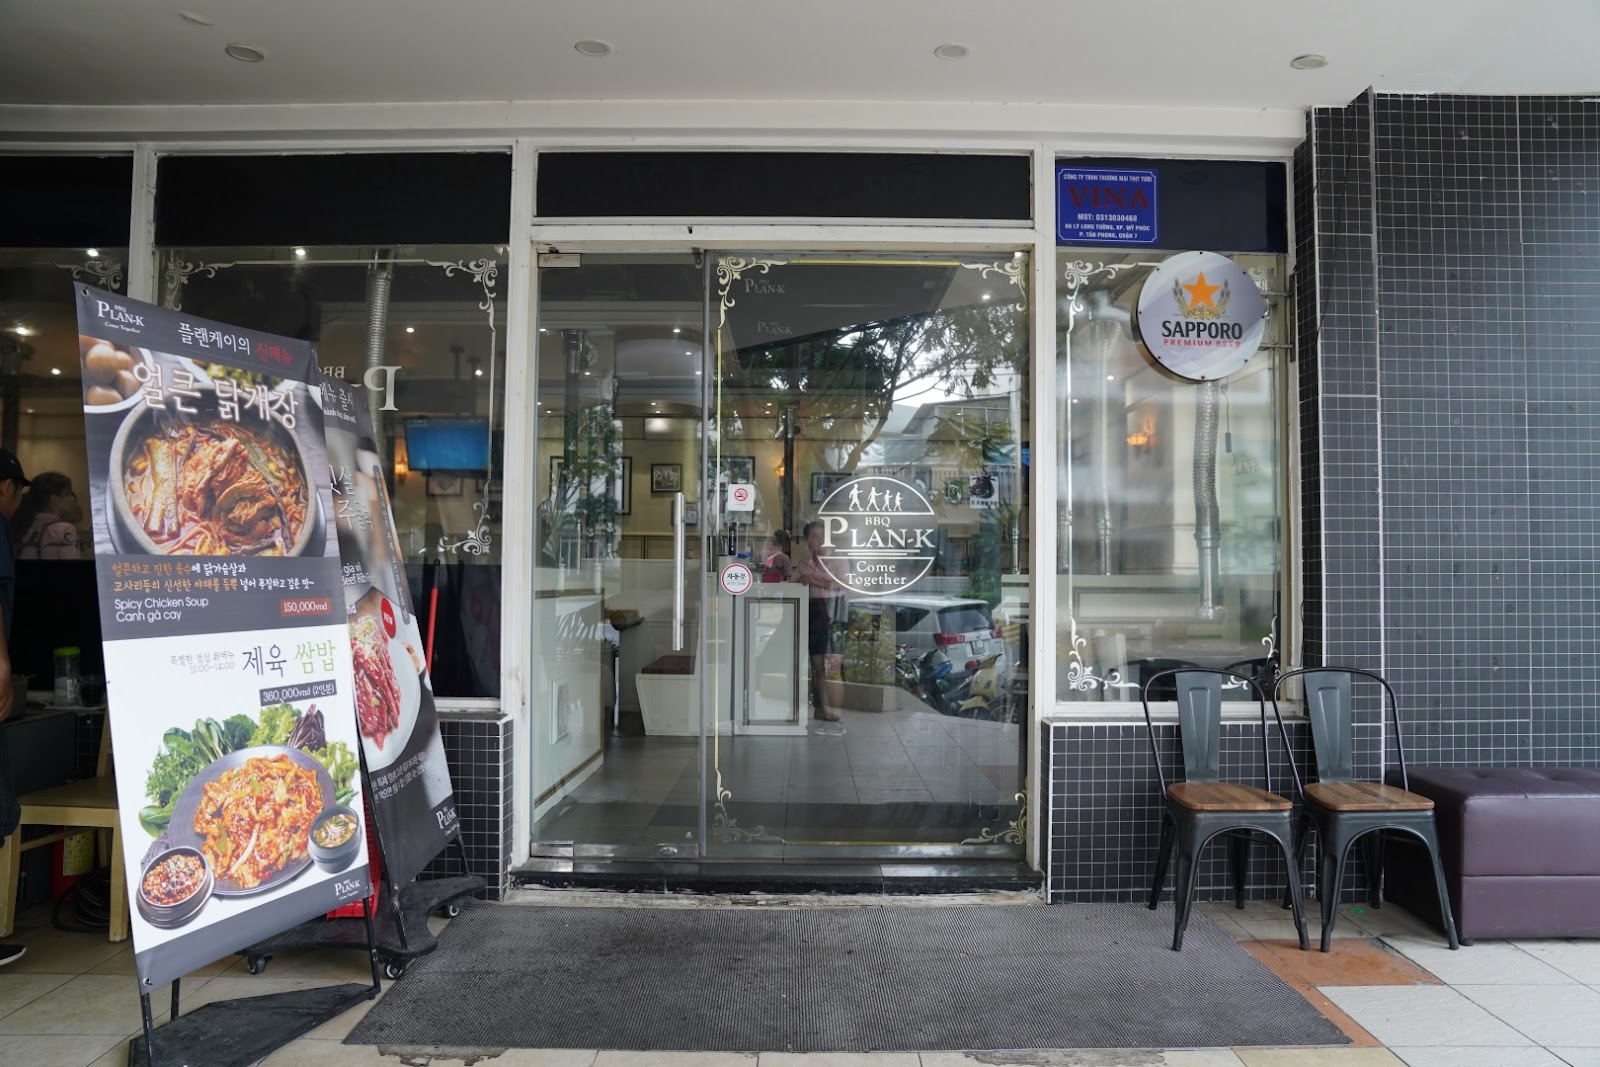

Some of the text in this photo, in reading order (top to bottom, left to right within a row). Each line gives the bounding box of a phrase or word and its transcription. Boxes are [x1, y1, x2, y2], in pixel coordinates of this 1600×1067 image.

[1069, 186, 1149, 208] VINA
[1162, 320, 1243, 340] SAPPORO
[178, 322, 250, 355] 플랜케이의
[1163, 339, 1241, 348] PREMIUM BEER
[133, 363, 298, 429] 얼큰 닭개장
[865, 516, 891, 527] BBQ
[820, 516, 935, 548] PLAN-K
[203, 562, 247, 577] 닭가슴살과
[856, 560, 896, 573] Come
[114, 580, 160, 593] 고사리등의
[164, 579, 191, 592] 신선한
[845, 573, 907, 586] Together
[114, 596, 209, 611] Spicy Chicken Soup
[283, 601, 327, 613] 150,000vnd
[116, 610, 181, 623] Canh gà cay
[242, 640, 336, 677] 제육 쌈밥
[263, 687, 311, 703] 360,000vnd
